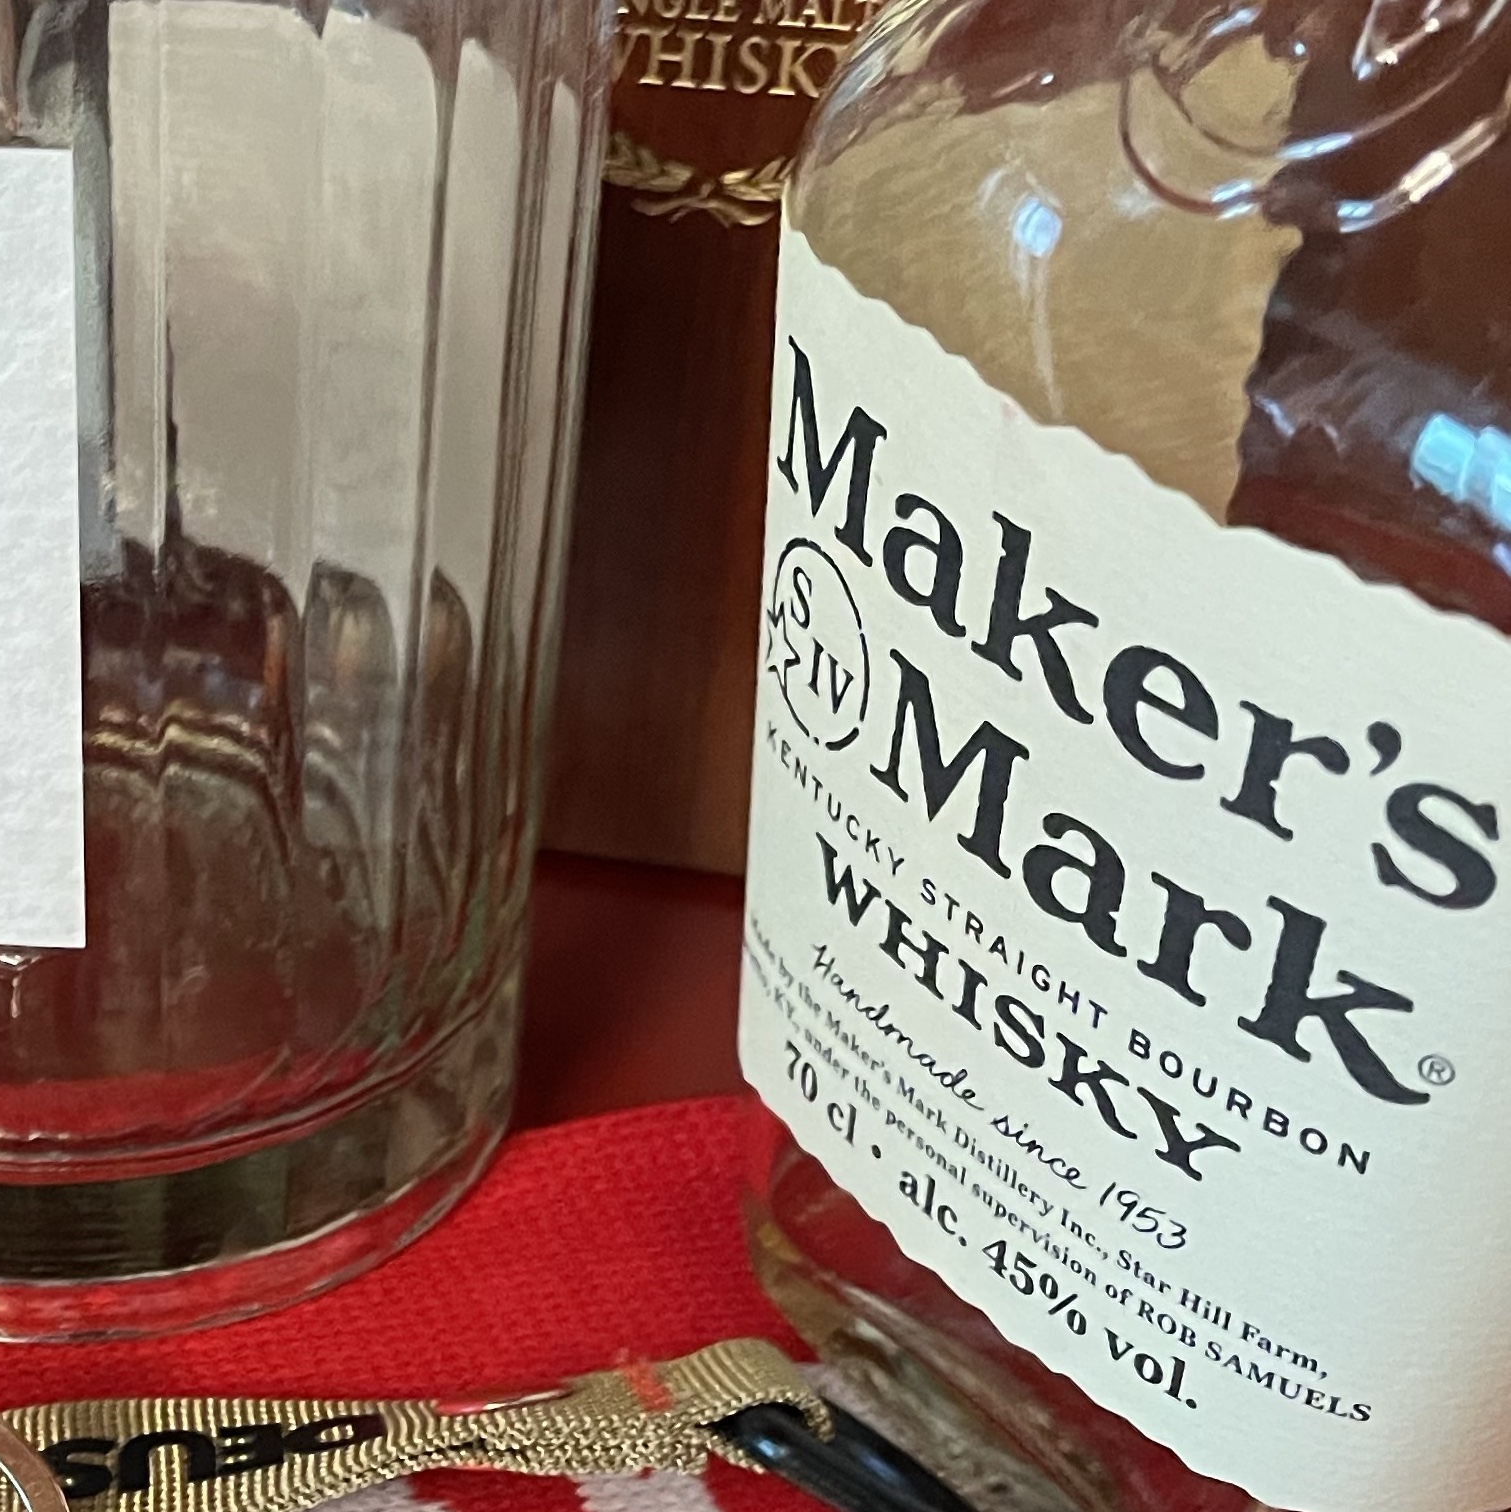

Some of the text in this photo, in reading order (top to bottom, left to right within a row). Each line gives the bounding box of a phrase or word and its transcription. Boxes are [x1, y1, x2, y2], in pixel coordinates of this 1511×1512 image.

[791, 566, 813, 630] S
[807, 637, 855, 715] IV
[767, 719, 1371, 1175] KENTUCKY STRAIGHT BOURBON
[810, 942, 986, 1112] Handmade
[991, 1115, 1088, 1190] since
[1099, 1181, 1188, 1250] 1953
[816, 831, 1242, 1182] WHISKY
[784, 1038, 1198, 1410] 70 cl alc. 45% vol.
[803, 1028, 851, 1081] under
[854, 1075, 882, 1113] the
[885, 1108, 968, 1187] personal
[972, 1181, 1098, 1287] supervision
[1104, 1282, 1135, 1307] of
[1136, 1298, 1197, 1348] ROB
[1204, 1340, 1373, 1423] SAMUELS
[898, 1076, 948, 1135] Mark
[954, 1125, 1055, 1218] Distillery
[1059, 1206, 1109, 1261] Inc.,
[1115, 1248, 1172, 1296] Star
[1179, 1286, 1233, 1332] Hill
[1241, 1320, 1329, 1382] Farm,
[41, 1411, 388, 1500] DEUS
